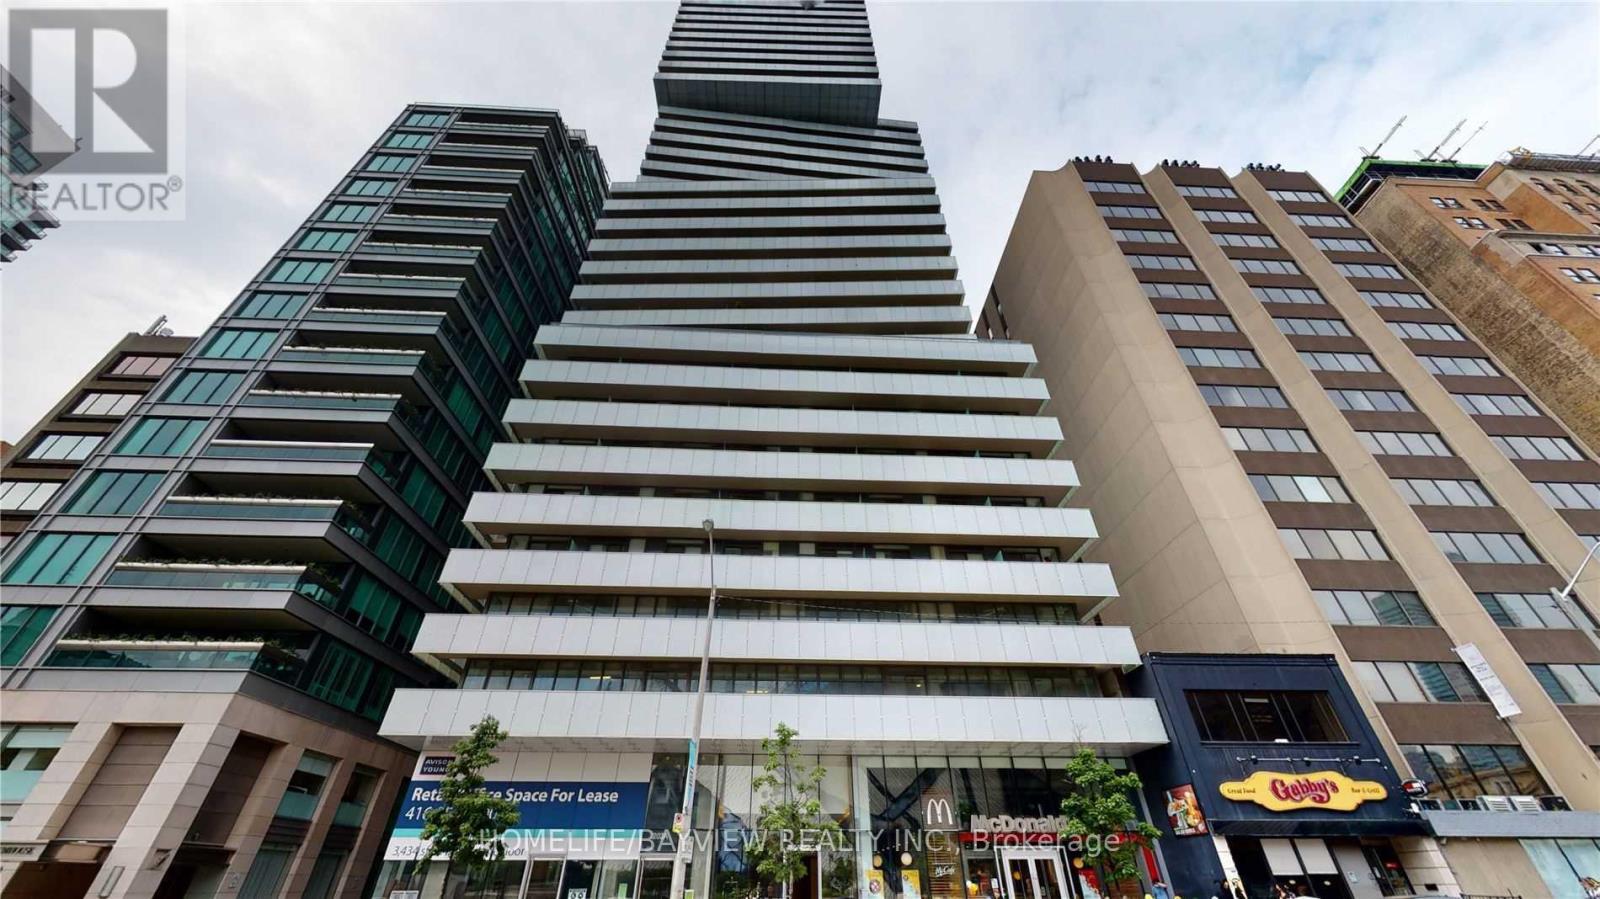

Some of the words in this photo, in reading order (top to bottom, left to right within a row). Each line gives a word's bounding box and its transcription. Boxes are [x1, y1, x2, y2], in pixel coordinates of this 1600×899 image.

[411, 787, 450, 802] Reta
[505, 787, 548, 803] Space
[550, 788, 575, 802] For
[577, 788, 619, 802] Lease
[1270, 778, 1340, 804] Gabby's
[970, 814, 1068, 832] McDonald
